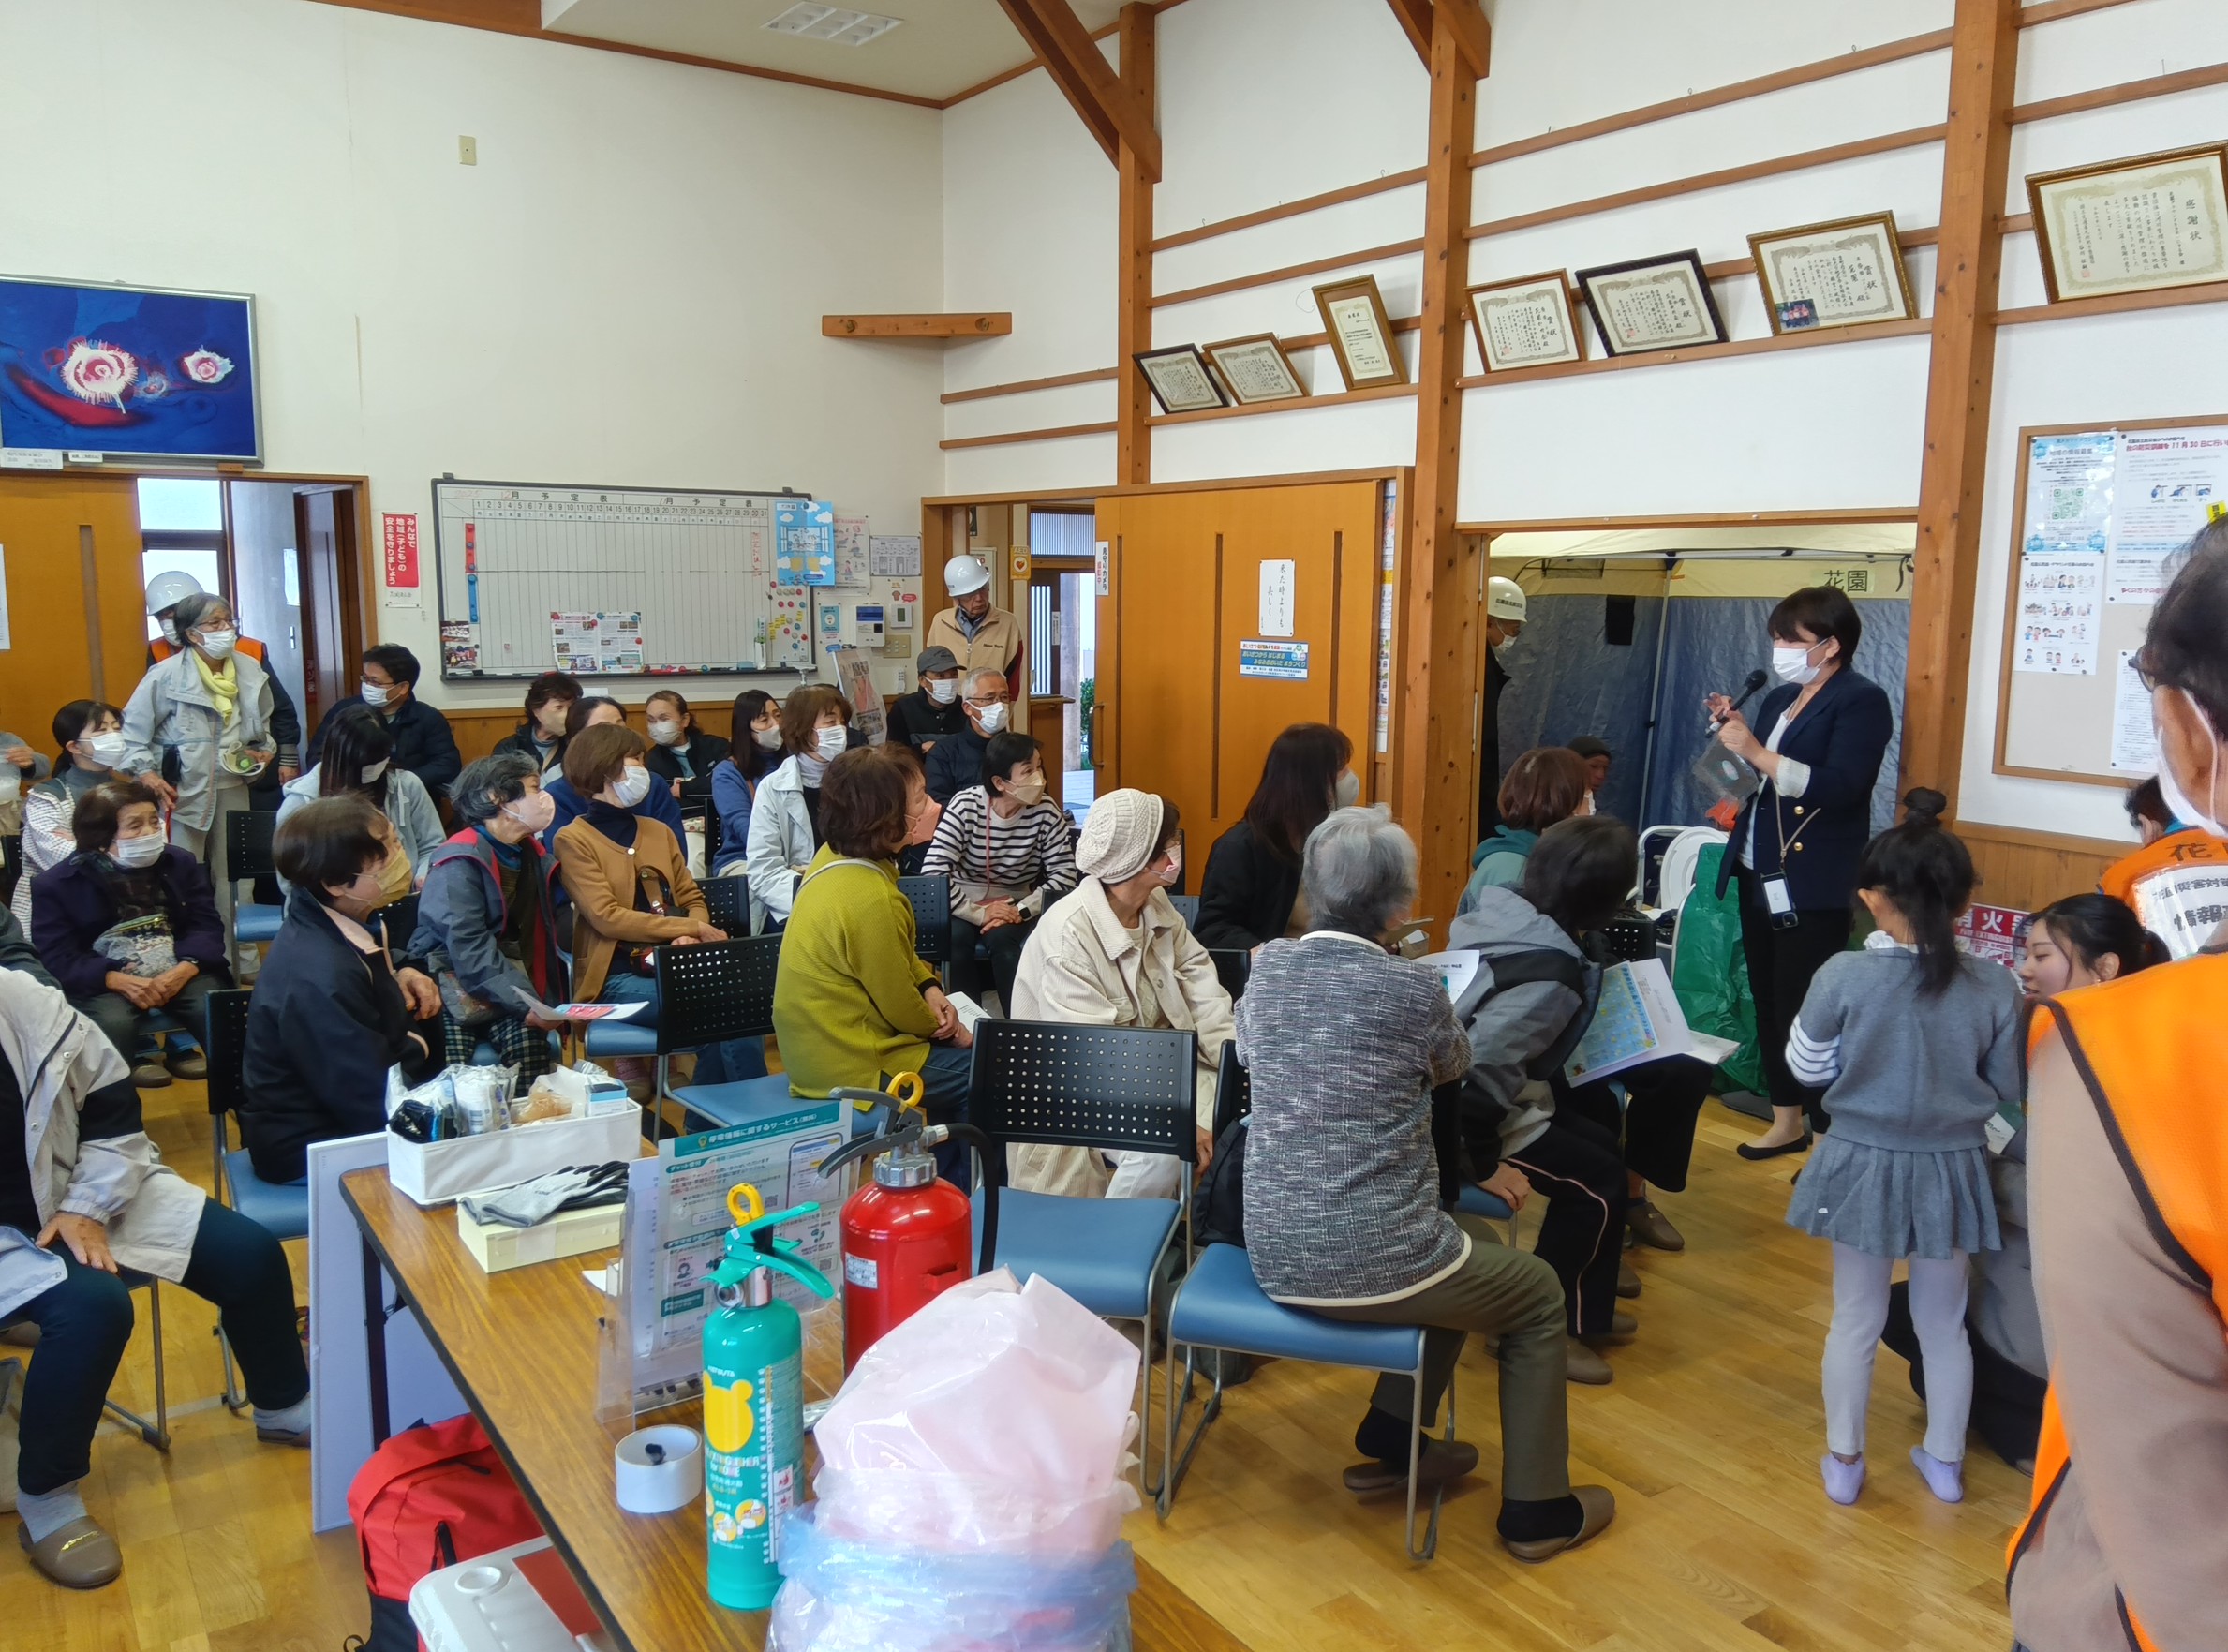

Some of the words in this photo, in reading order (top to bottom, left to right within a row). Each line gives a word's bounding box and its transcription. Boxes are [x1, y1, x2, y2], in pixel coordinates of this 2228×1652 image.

[2186, 199, 2202, 241] 感謝状
[1864, 265, 1878, 289] 賞状
[1678, 297, 1692, 318] 賞状
[407, 517, 415, 548] みんなで
[385, 517, 395, 585] 安全を守りましょう
[1823, 569, 1868, 592] 花園
[2174, 904, 2228, 931] 情報
